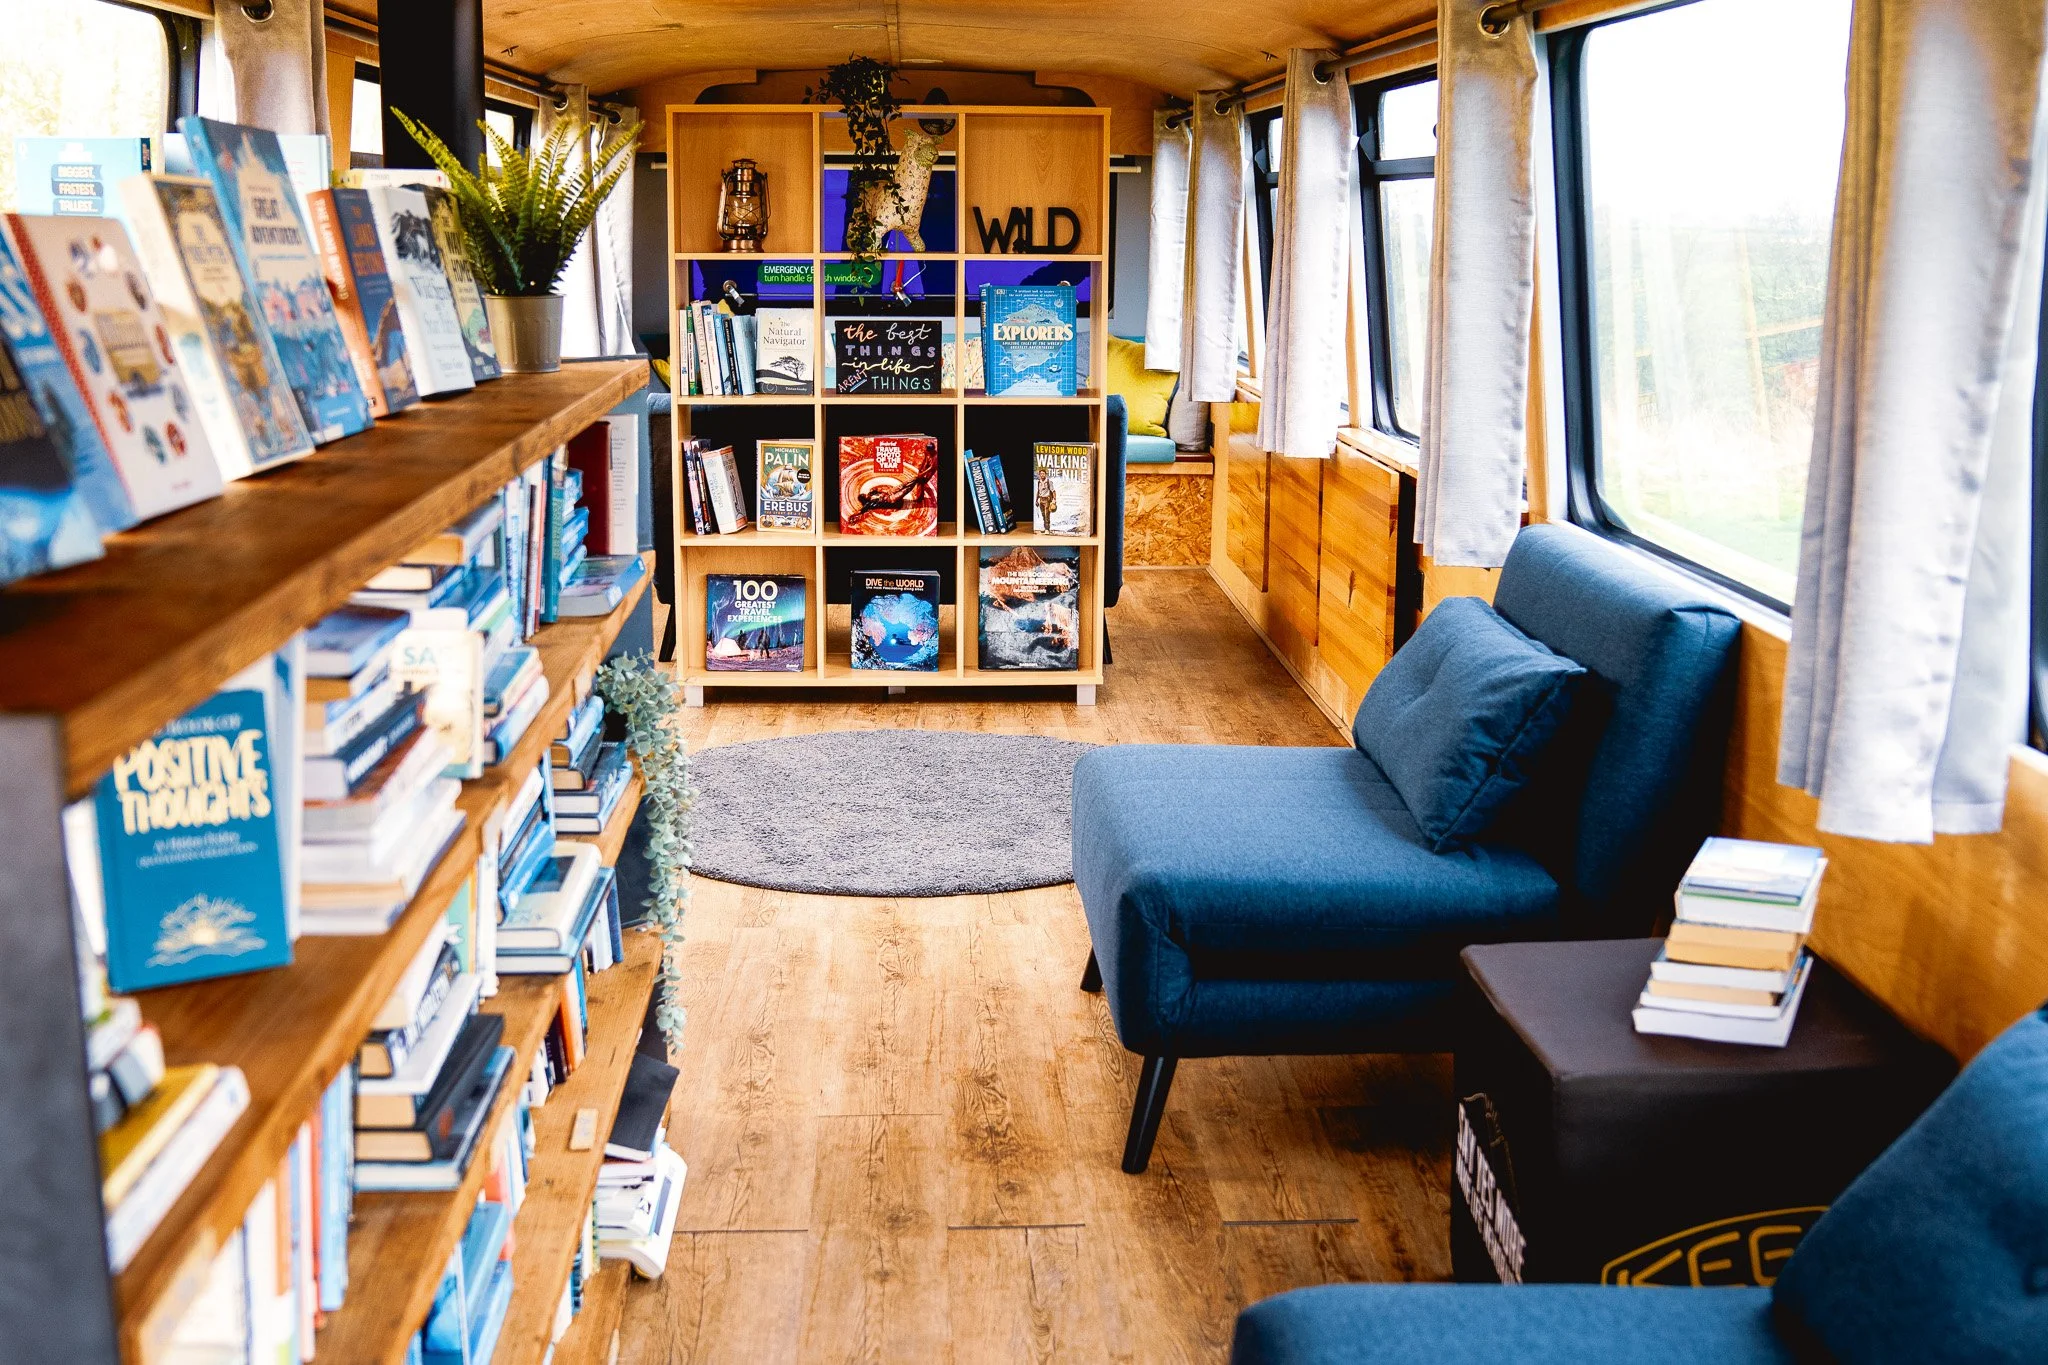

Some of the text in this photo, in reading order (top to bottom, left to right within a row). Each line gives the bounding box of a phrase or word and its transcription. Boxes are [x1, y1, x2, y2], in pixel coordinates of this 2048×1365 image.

[972, 206, 1080, 254] WILD
[764, 266, 809, 274] EMERGENCY
[780, 274, 805, 282] handle
[768, 327, 802, 336] Natural
[844, 322, 932, 345] the best
[993, 323, 1074, 341] EXPLORERS
[763, 336, 806, 346] Navigator
[845, 344, 936, 358] THINGS
[878, 358, 926, 375] life
[871, 376, 931, 390] THINGS
[1036, 446, 1065, 454] LEVISON
[765, 452, 809, 466] PALIN
[1036, 454, 1087, 469] WALKING
[1048, 468, 1087, 484] THE NILE
[764, 501, 808, 512] EREBUS
[896, 579, 924, 587] WORLD
[992, 577, 1069, 585] MOUNTAINEERING
[733, 580, 778, 601] 100
[113, 729, 264, 794] POSITIVE
[117, 769, 272, 836] THOUGHTS
[1617, 1226, 1802, 1288] KEE
